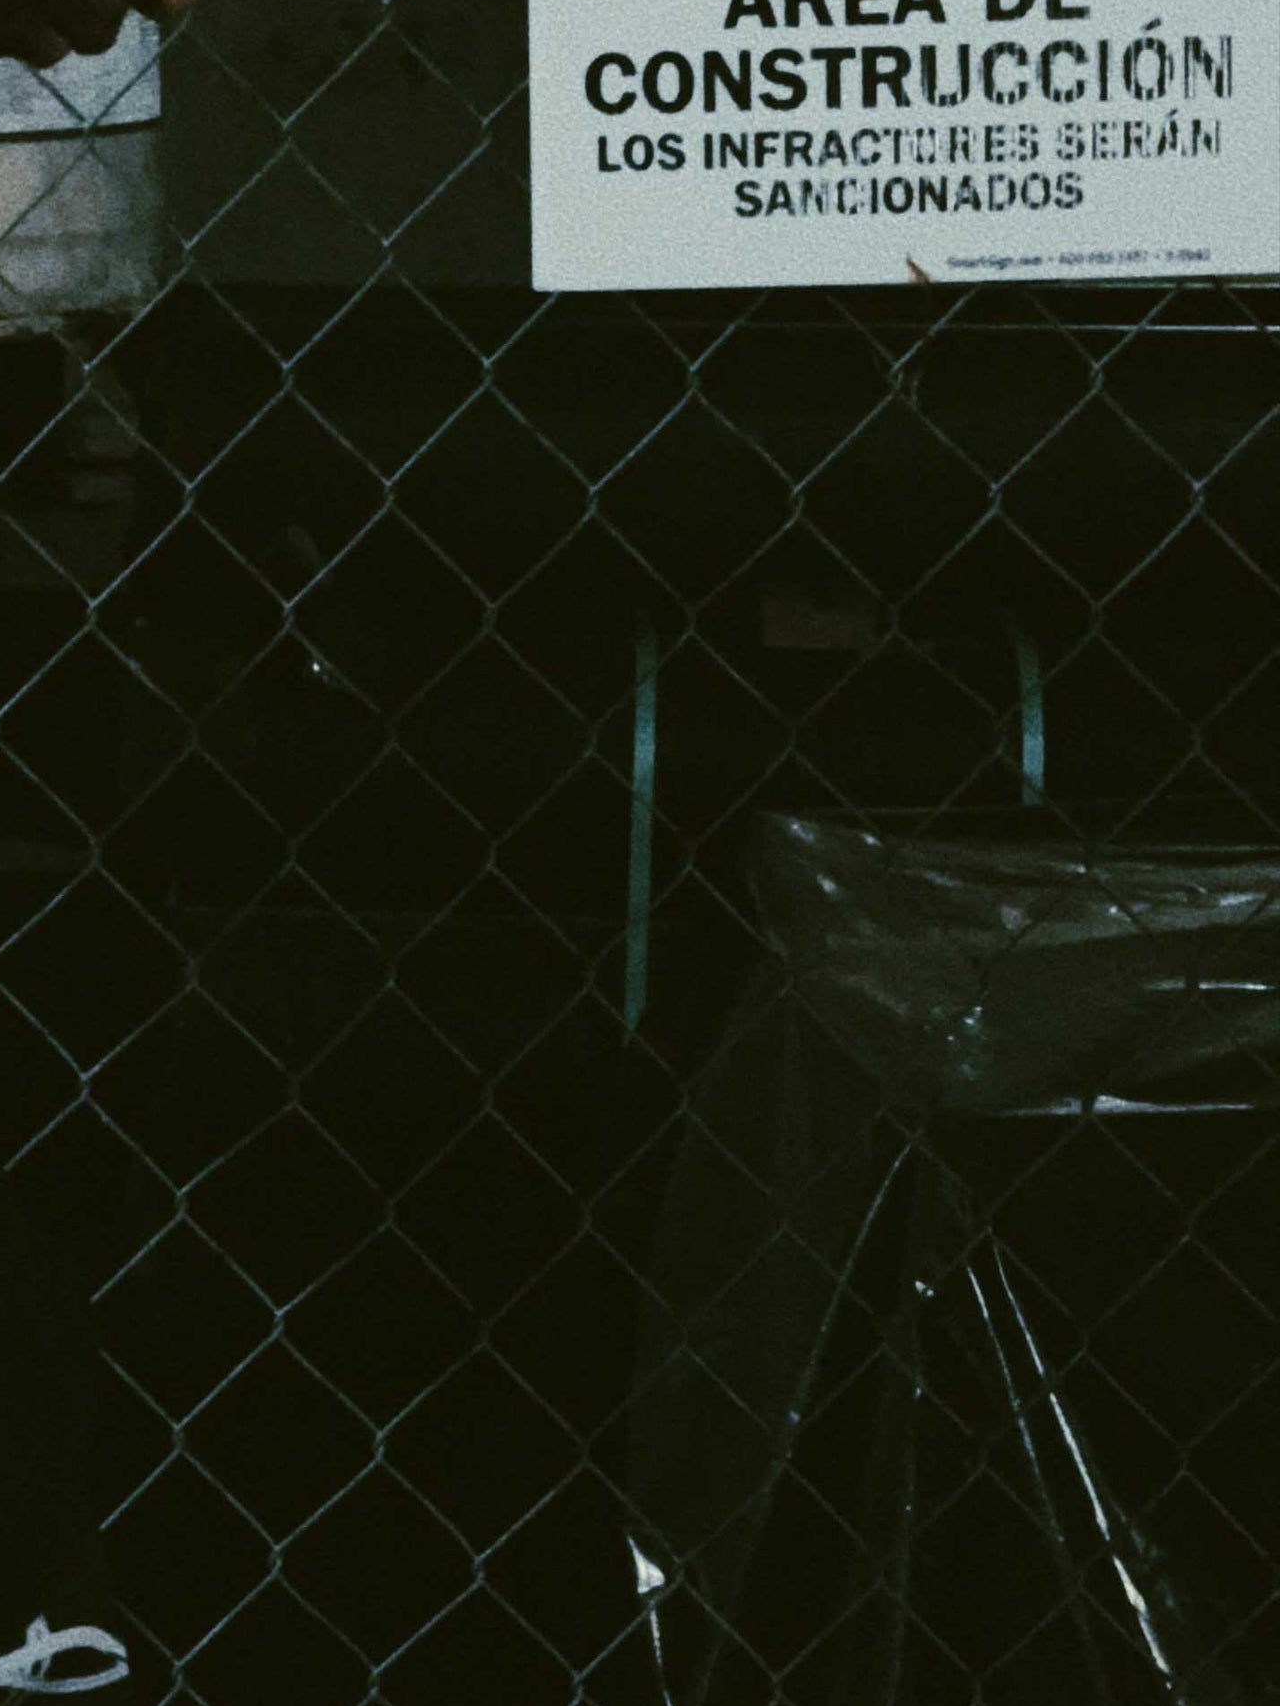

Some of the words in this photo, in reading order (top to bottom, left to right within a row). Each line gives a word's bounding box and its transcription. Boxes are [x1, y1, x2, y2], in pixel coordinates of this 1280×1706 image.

[584, 18, 1232, 115] CONSTRUCCIÓN
[598, 133, 685, 172] LOS
[703, 123, 1039, 170] INFRACTORES
[734, 172, 1084, 218] SANCIONADOS
